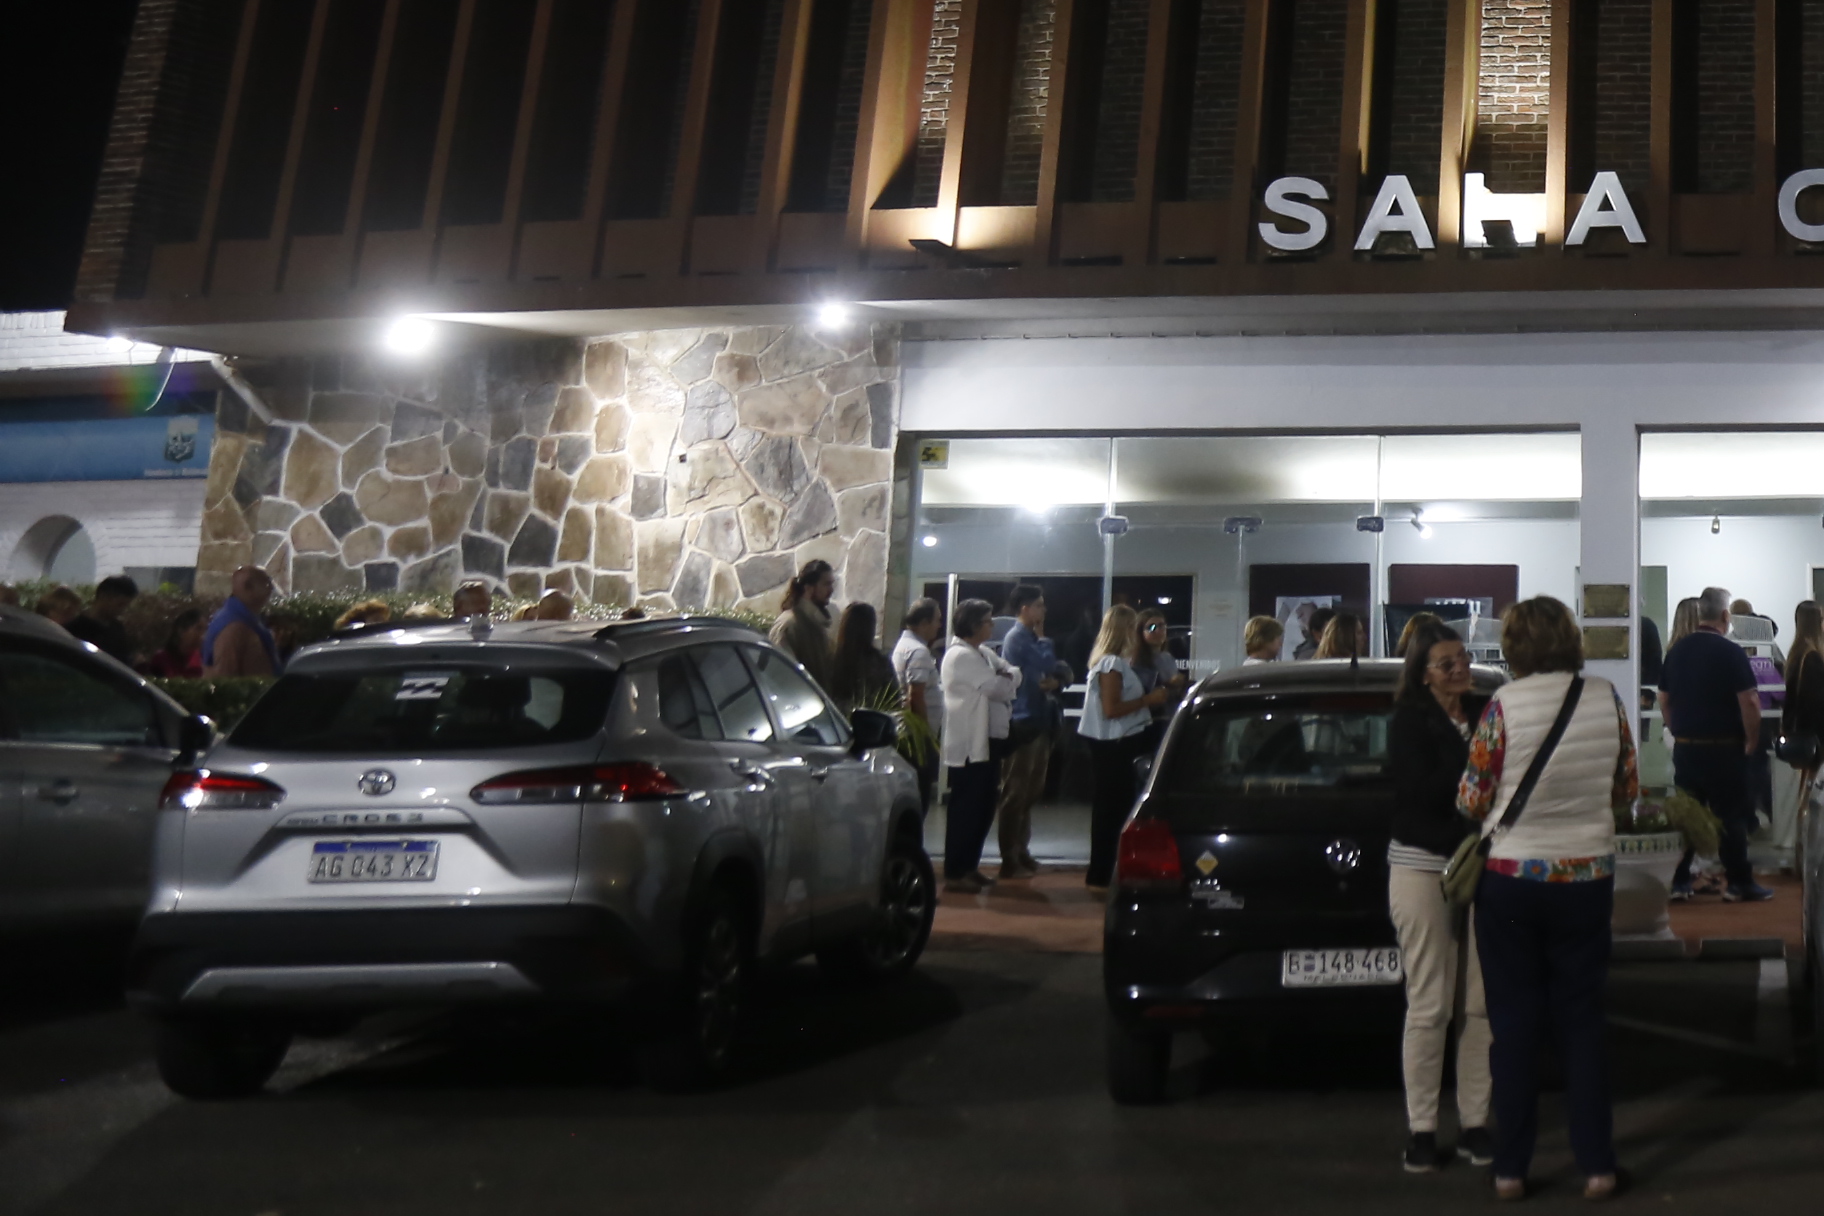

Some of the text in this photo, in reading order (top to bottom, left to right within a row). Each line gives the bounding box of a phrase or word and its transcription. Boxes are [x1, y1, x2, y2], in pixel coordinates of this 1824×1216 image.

[1257, 170, 1648, 251] SALA
[315, 855, 344, 877] AG
[351, 855, 394, 877] 043
